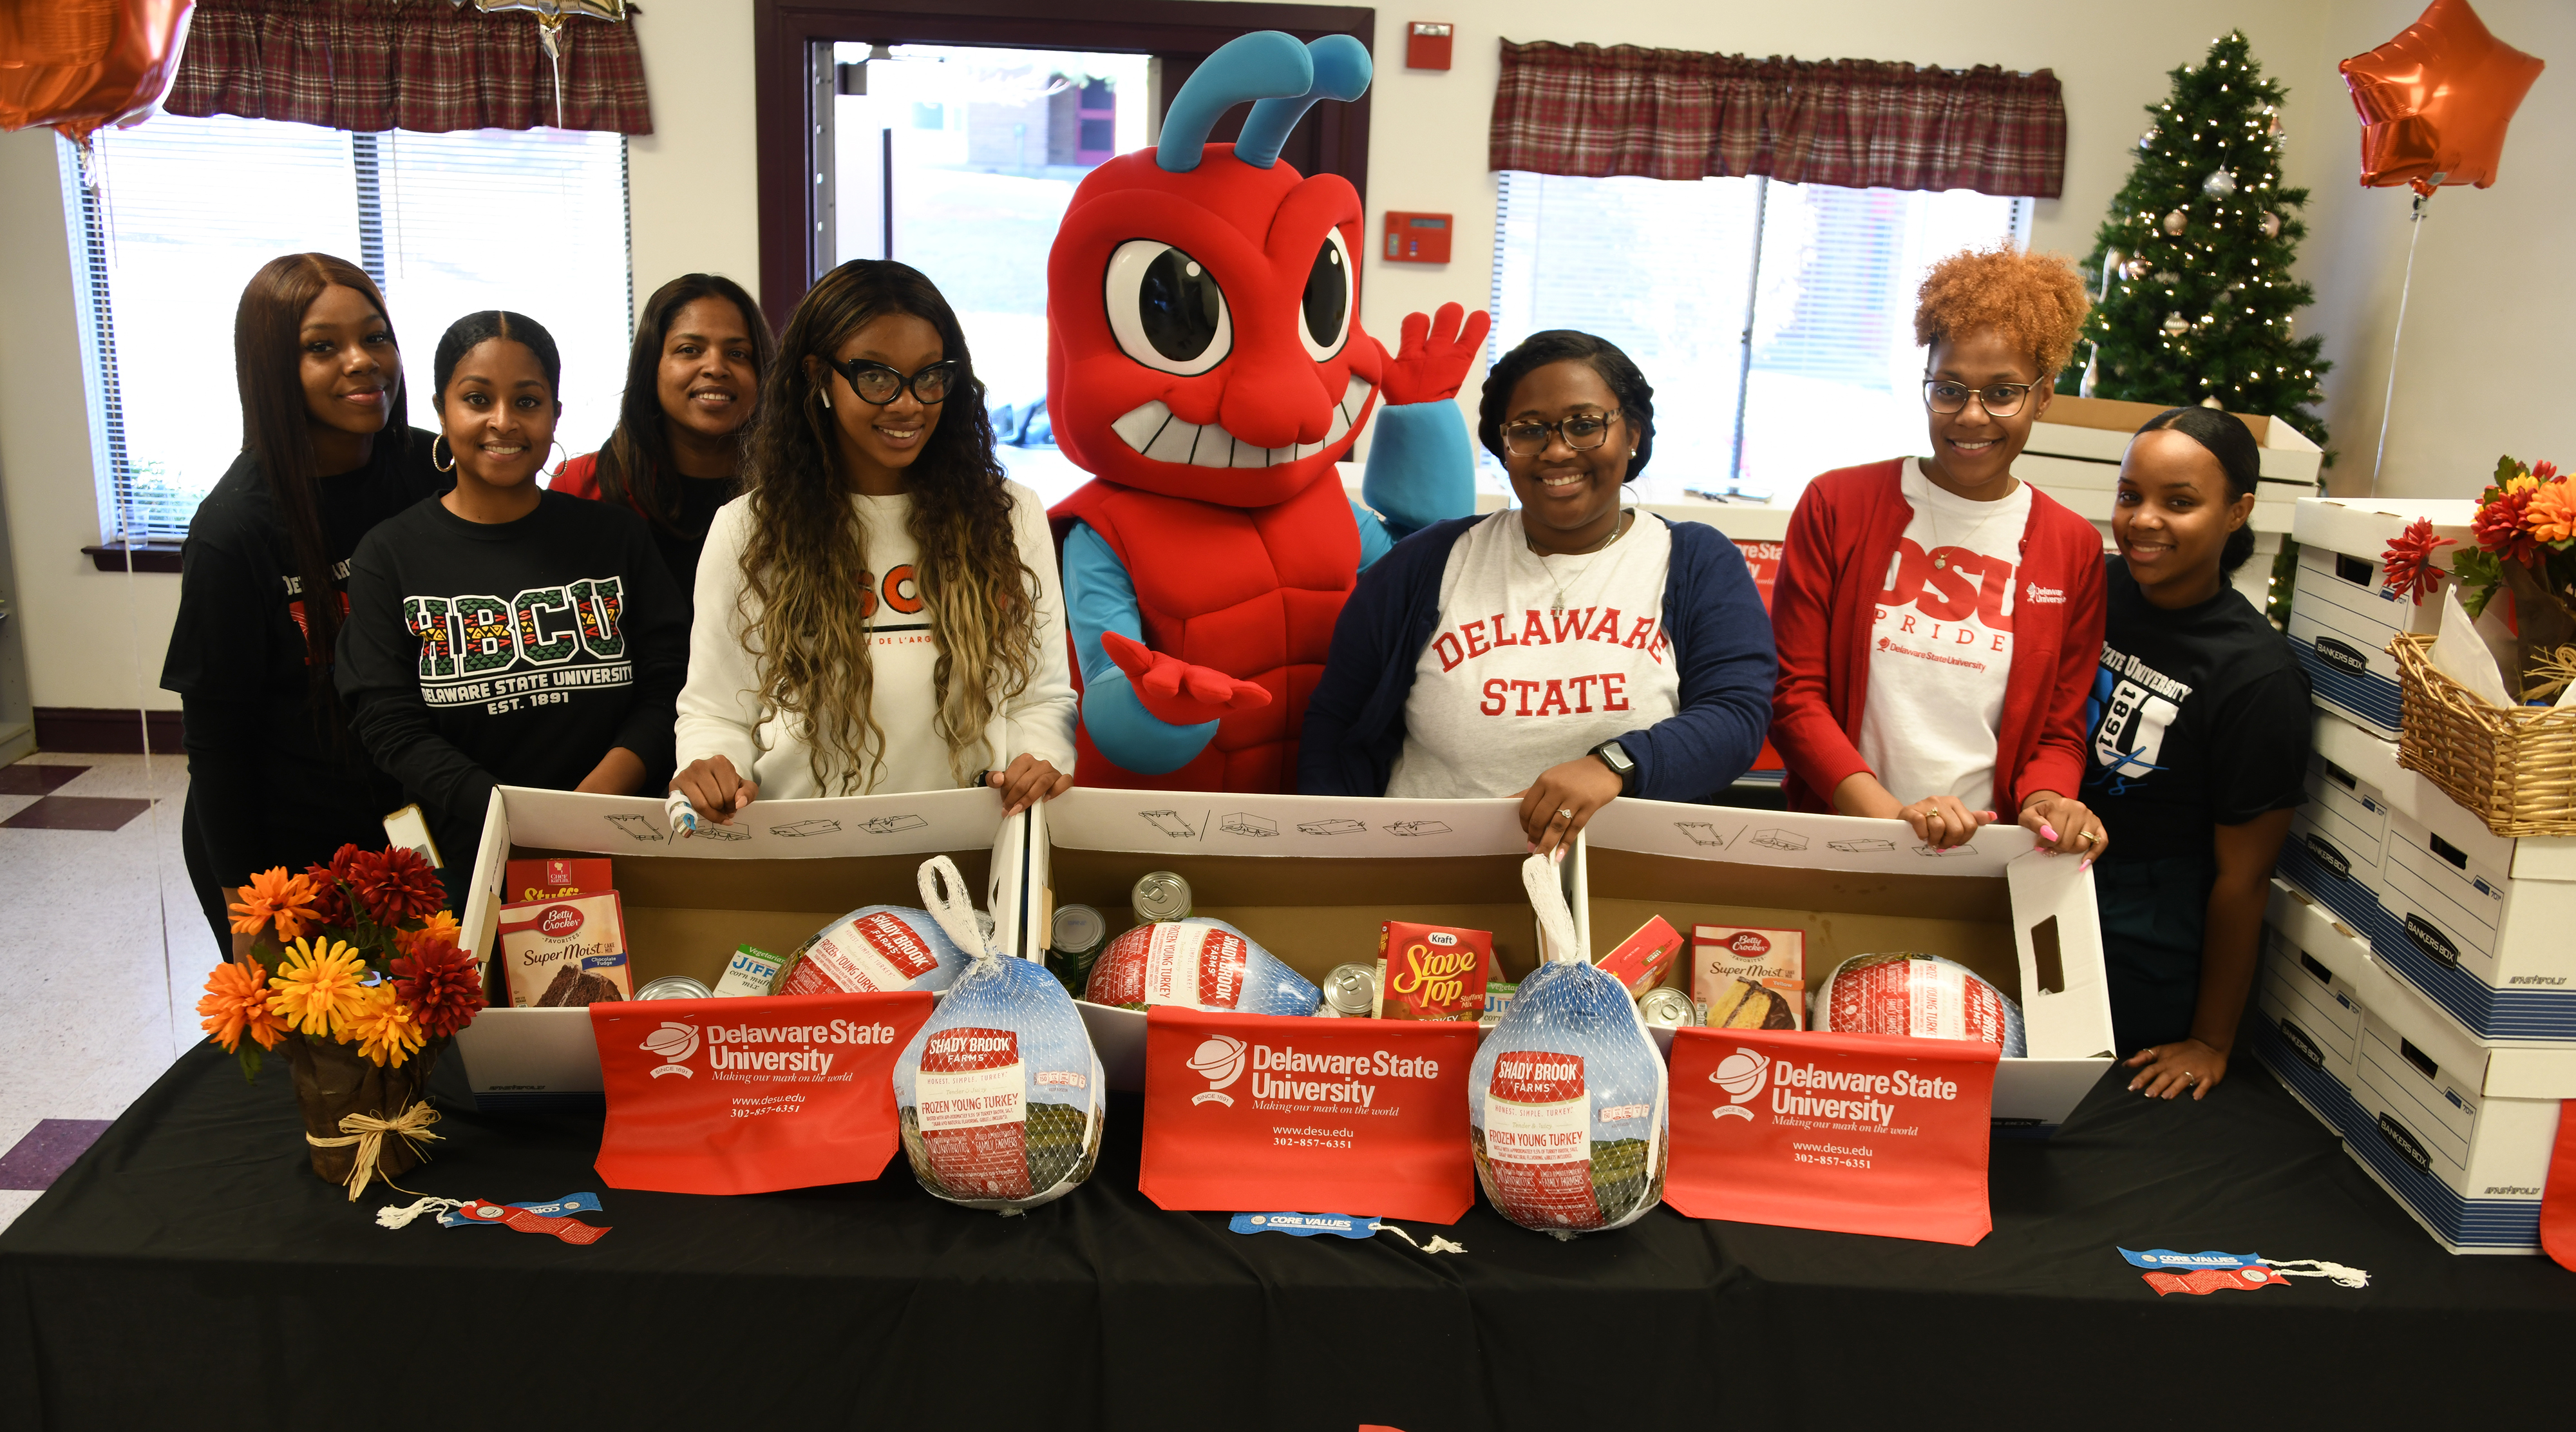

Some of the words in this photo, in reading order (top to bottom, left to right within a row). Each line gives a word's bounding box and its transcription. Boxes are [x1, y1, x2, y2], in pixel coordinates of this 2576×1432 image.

[1759, 542, 1783, 560] Sta
[1875, 537, 2016, 633] DSU
[2036, 586, 2064, 596] Delawar
[403, 575, 625, 680] HBCU
[1872, 607, 2005, 653] PRIDE
[899, 635, 931, 644] L'ARG
[1432, 606, 1669, 673] DELAWARE
[1890, 642, 1926, 659] Delaware
[1926, 652, 1947, 663] State
[1947, 656, 1987, 674] University
[2317, 643, 2348, 663] BANKERS
[2347, 656, 2363, 670] BOX
[421, 683, 491, 703] DELAWARE
[495, 674, 549, 694] STATE
[553, 665, 633, 686] UNIVERSITY
[2124, 654, 2193, 703] UNIVERSITY
[488, 698, 525, 716] EST.
[530, 692, 569, 707] 1891
[1480, 673, 1630, 716] STATE
[2099, 686, 2137, 749] 1891
[2307, 840, 2334, 864] BANKERS
[2333, 859, 2347, 874] BOX
[543, 918, 578, 931] Crocker
[548, 910, 573, 922] Betty
[544, 932, 580, 944] FAVORITES
[870, 914, 902, 937] SHADY
[893, 932, 929, 968] BROOK
[872, 930, 899, 955] FARMS
[1165, 924, 1181, 944] FROZEN
[1432, 934, 1453, 944] Kraft
[1738, 935, 1762, 946] Betty
[2407, 921, 2439, 951] BANKERS
[2438, 944, 2454, 962] BOX
[524, 950, 562, 967] Super
[563, 942, 603, 960] Moist
[819, 938, 840, 959] FROZEN
[836, 953, 860, 977] YOUNG
[1161, 943, 1175, 966] YOUNG
[1220, 935, 1239, 962] SHADY
[1732, 941, 1765, 952] Crocker
[1208, 945, 1220, 974] FARMS
[1393, 944, 1477, 994] Stove
[1710, 961, 1746, 977] Super
[1747, 964, 1785, 977] Moist
[1731, 955, 1765, 963] FAVORITES
[729, 969, 748, 979] corn
[750, 975, 772, 987] muff
[741, 980, 760, 991] mix
[1159, 968, 1173, 998] TURKEY
[1490, 982, 1517, 992] Vegetar
[1419, 978, 1463, 1009] Top
[1459, 993, 1483, 1003] Stuffing
[1926, 986, 1937, 1011] YOUNG
[1980, 984, 1996, 1017] SHADY
[1973, 993, 1982, 1025] FARMS
[706, 1024, 828, 1044] Delaware
[829, 1019, 895, 1044] State
[929, 1037, 969, 1055] SHADY
[969, 1037, 1010, 1052] BROOK
[2282, 1025, 2308, 1053] BANKERS
[2307, 1048, 2320, 1065] BOX
[655, 1066, 674, 1074] SINCE
[709, 1045, 834, 1076] University
[947, 1054, 984, 1063] FARMS
[1253, 1045, 1370, 1075] Delaware
[1372, 1050, 1439, 1080] State
[712, 1071, 752, 1084] Making
[772, 1073, 797, 1083] mark
[811, 1073, 825, 1082] the
[826, 1071, 853, 1083] world
[1498, 1061, 1533, 1080] SHADY
[1534, 1062, 1577, 1081] BROOK
[1774, 1060, 1891, 1094] Delaware
[1892, 1069, 1958, 1100] State
[732, 1093, 806, 1105] www.desu.edu
[1196, 1093, 1215, 1102] SINCE
[1217, 1094, 1229, 1103] 1891
[1252, 1073, 1376, 1108] University
[1514, 1082, 1550, 1093] FARMS
[730, 1104, 800, 1118] 302-857-6351
[922, 1100, 950, 1115] FROZEN
[951, 1097, 981, 1112] YOUNG
[983, 1093, 1019, 1109] TURKEY
[1251, 1100, 1292, 1114] Making
[1312, 1103, 1338, 1114] mark
[1354, 1105, 1370, 1116] the
[1371, 1105, 1399, 1117] world
[1772, 1087, 1895, 1127] University
[1273, 1124, 1354, 1138] www.desu.edu
[1772, 1114, 1812, 1131] Making
[1813, 1121, 1831, 1129] our
[1832, 1120, 1858, 1132] mark
[1873, 1123, 1889, 1134] the
[1890, 1125, 1919, 1137] world
[1273, 1137, 1352, 1149] 302-857-6351
[1489, 1129, 1516, 1146] FROZEN
[1517, 1132, 1547, 1147] YOUNG
[1548, 1131, 1583, 1146] TURKEY
[1792, 1141, 1873, 1157] www.desu.edu
[2381, 1120, 2412, 1154] BANKERS
[2411, 1148, 2427, 1169] BOX
[1794, 1153, 1871, 1169] 302-857-6351
[1270, 1216, 1303, 1225] CORE
[1304, 1217, 1351, 1228] VALUES
